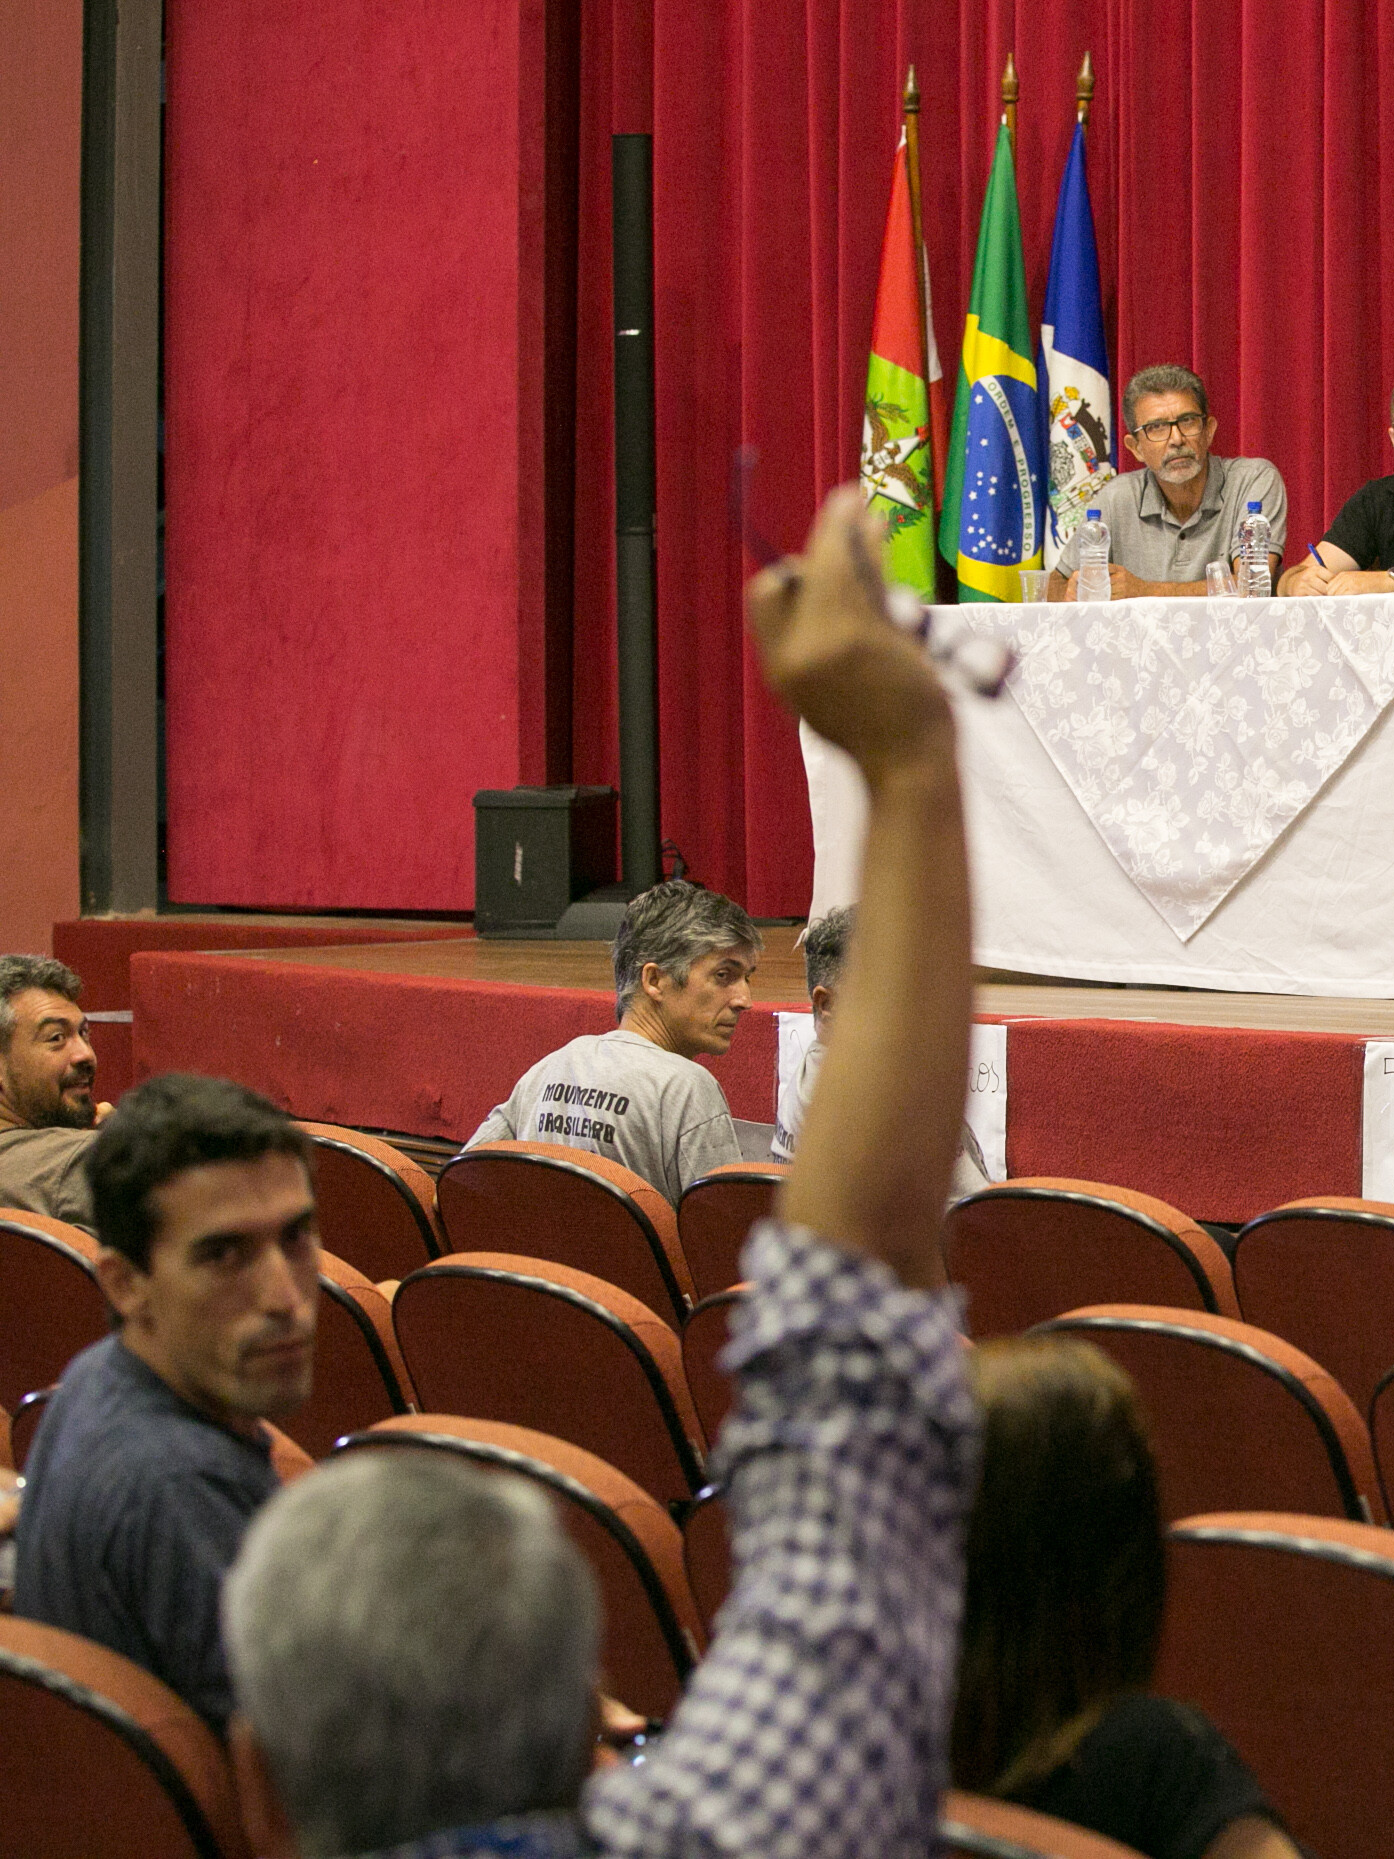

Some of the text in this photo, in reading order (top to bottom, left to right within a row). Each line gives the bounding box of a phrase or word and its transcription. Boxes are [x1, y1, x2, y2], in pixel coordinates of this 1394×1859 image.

[987, 381, 1015, 430] ORDEM
[1017, 457, 1034, 552] PROGRESSO
[541, 1083, 630, 1115] MOVIMENTO
[538, 1112, 616, 1144] BRASILEIRO
